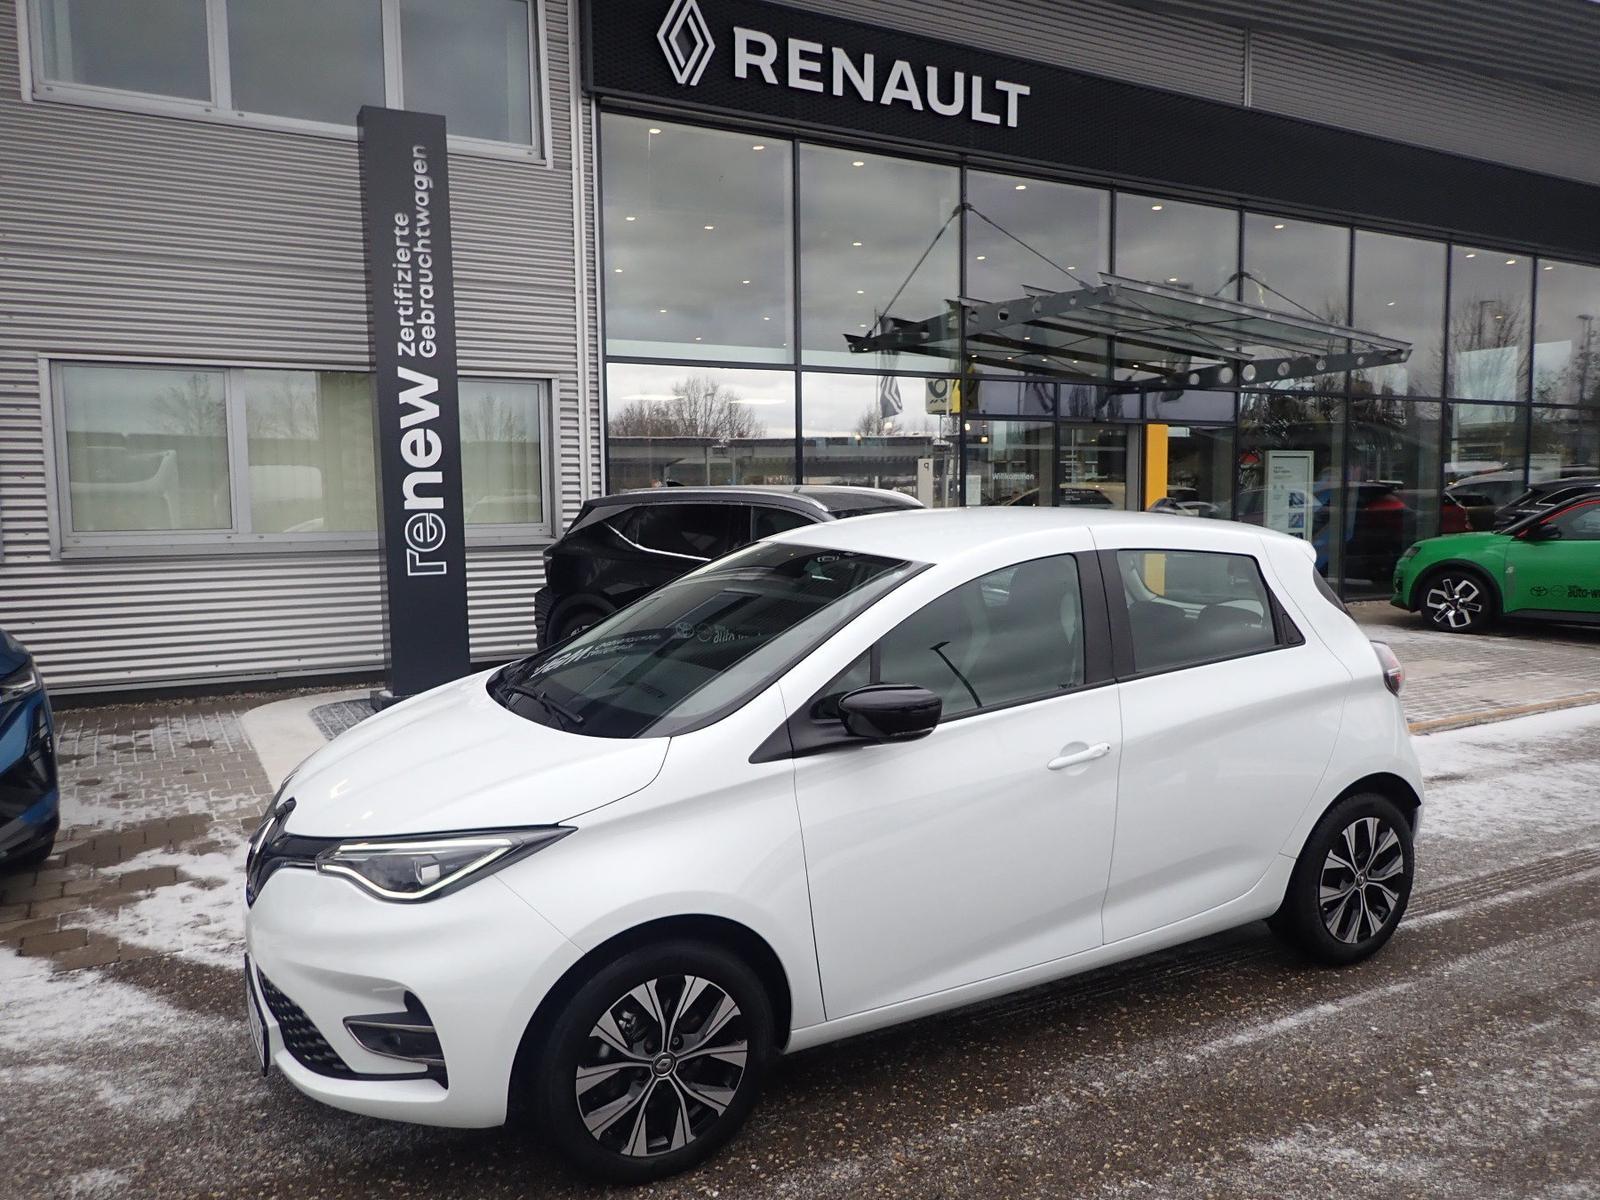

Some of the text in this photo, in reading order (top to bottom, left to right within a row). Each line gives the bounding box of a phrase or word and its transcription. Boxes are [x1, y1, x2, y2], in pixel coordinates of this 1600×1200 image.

[733, 26, 1030, 128] RENAULT
[392, 212, 416, 357] Zertifizierte
[413, 145, 437, 358] Gebrauchtwagen
[397, 366, 447, 576] renew
